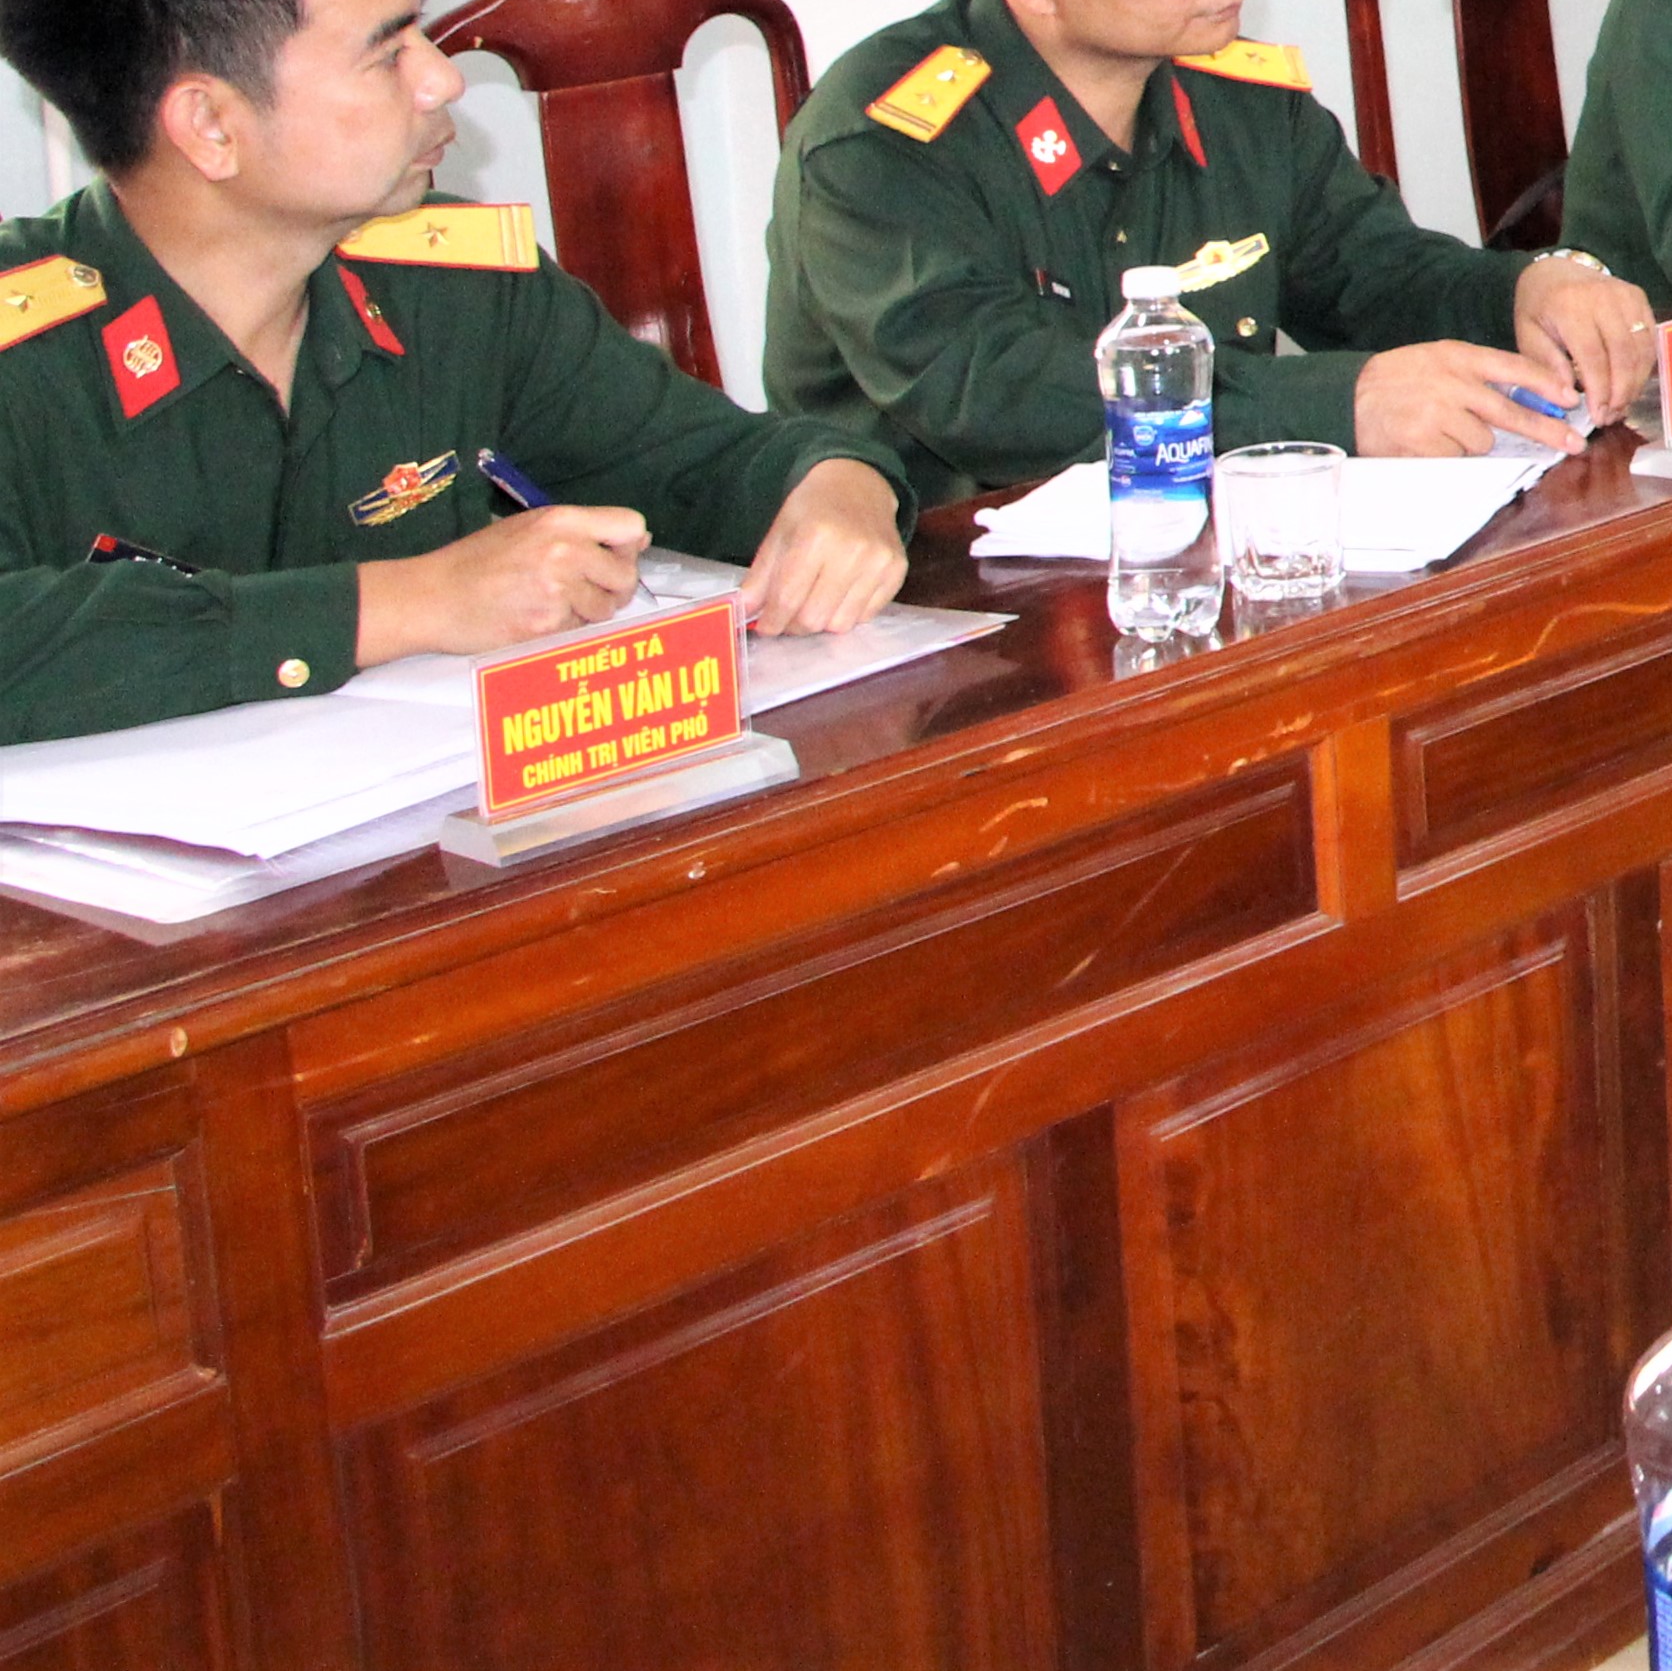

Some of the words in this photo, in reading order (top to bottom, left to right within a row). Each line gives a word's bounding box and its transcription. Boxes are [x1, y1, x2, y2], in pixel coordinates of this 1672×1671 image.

[556, 643, 627, 683] THIẾU
[632, 633, 664, 661] TÁ
[502, 680, 613, 755] NGUYỄN
[618, 669, 674, 722] VĂN
[679, 656, 720, 709] LỢI
[522, 752, 584, 789] CHÍNH
[586, 740, 619, 768] TRỊ
[621, 724, 667, 760] VIÊN
[669, 709, 709, 745] PHÓ
